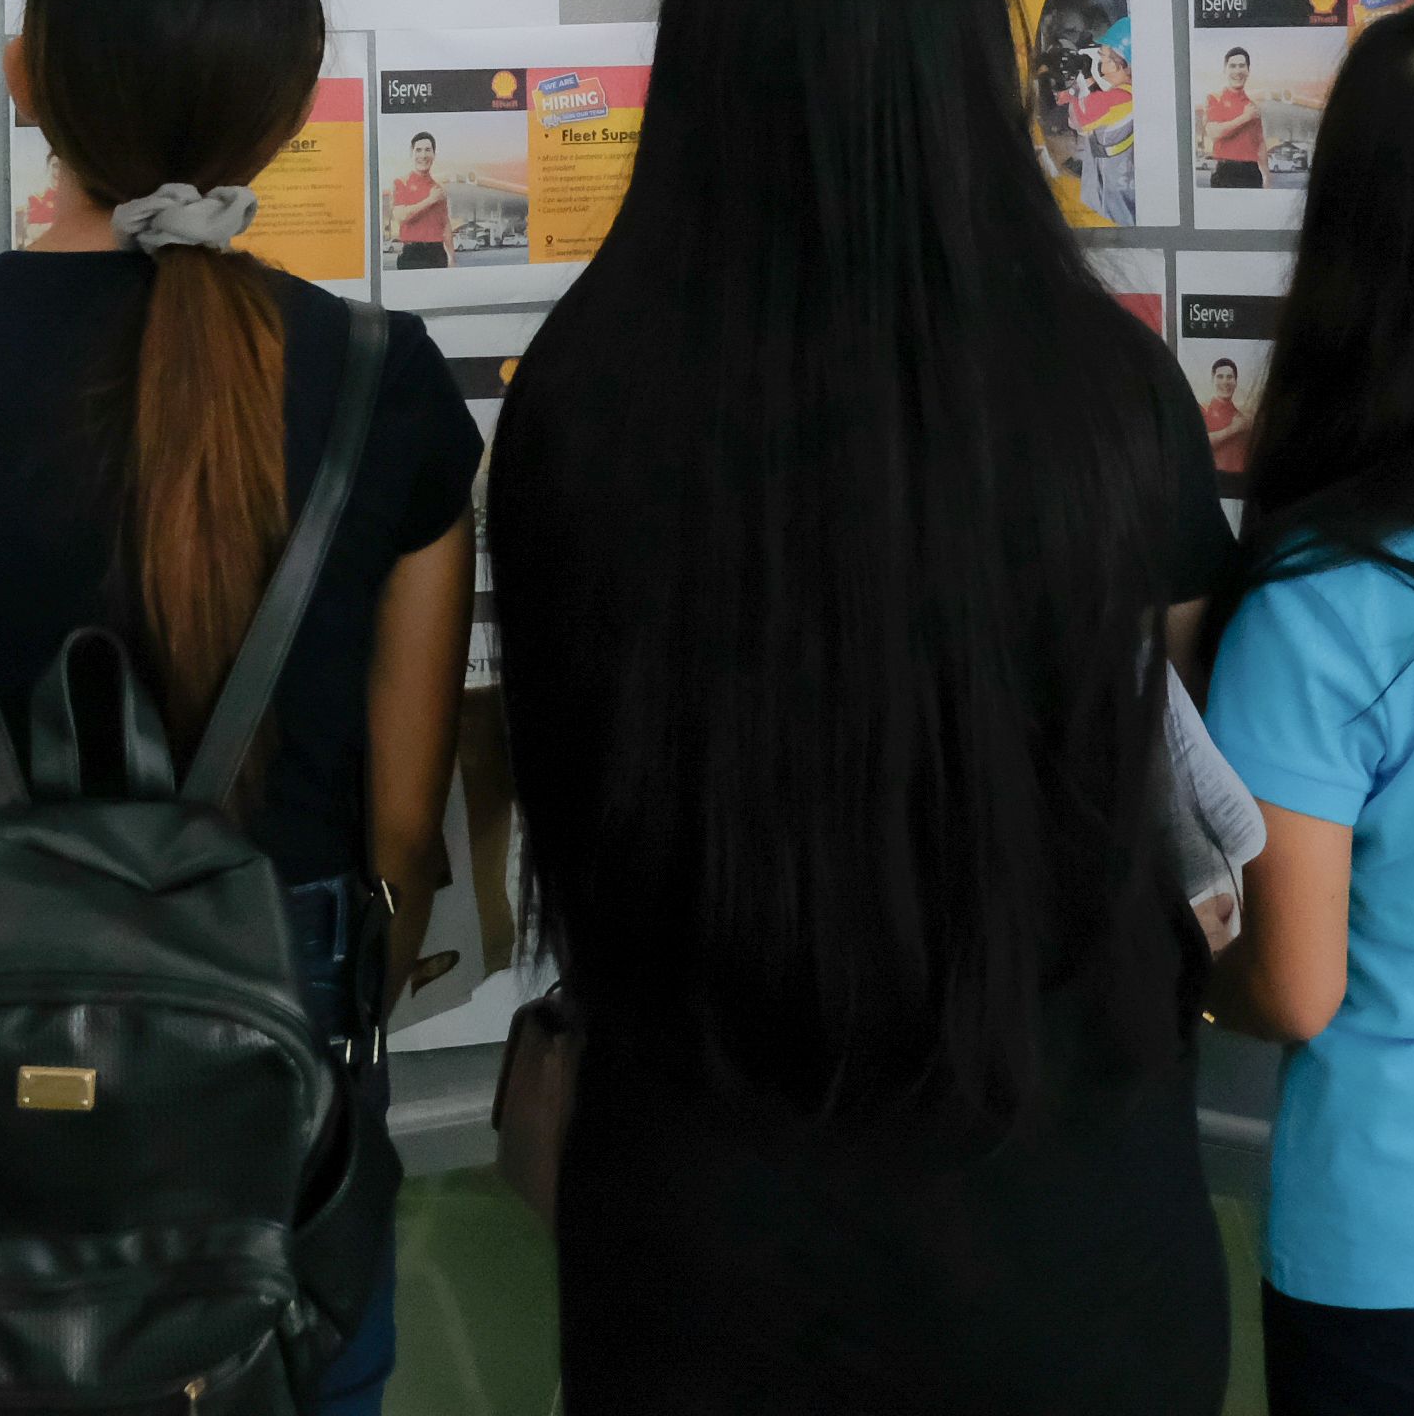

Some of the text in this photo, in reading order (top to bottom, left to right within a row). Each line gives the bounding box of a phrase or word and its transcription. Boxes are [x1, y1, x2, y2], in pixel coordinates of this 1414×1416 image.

[388, 80, 427, 98] iServe
[542, 91, 599, 111] HIRING
[562, 129, 642, 144] Fleet Supe
